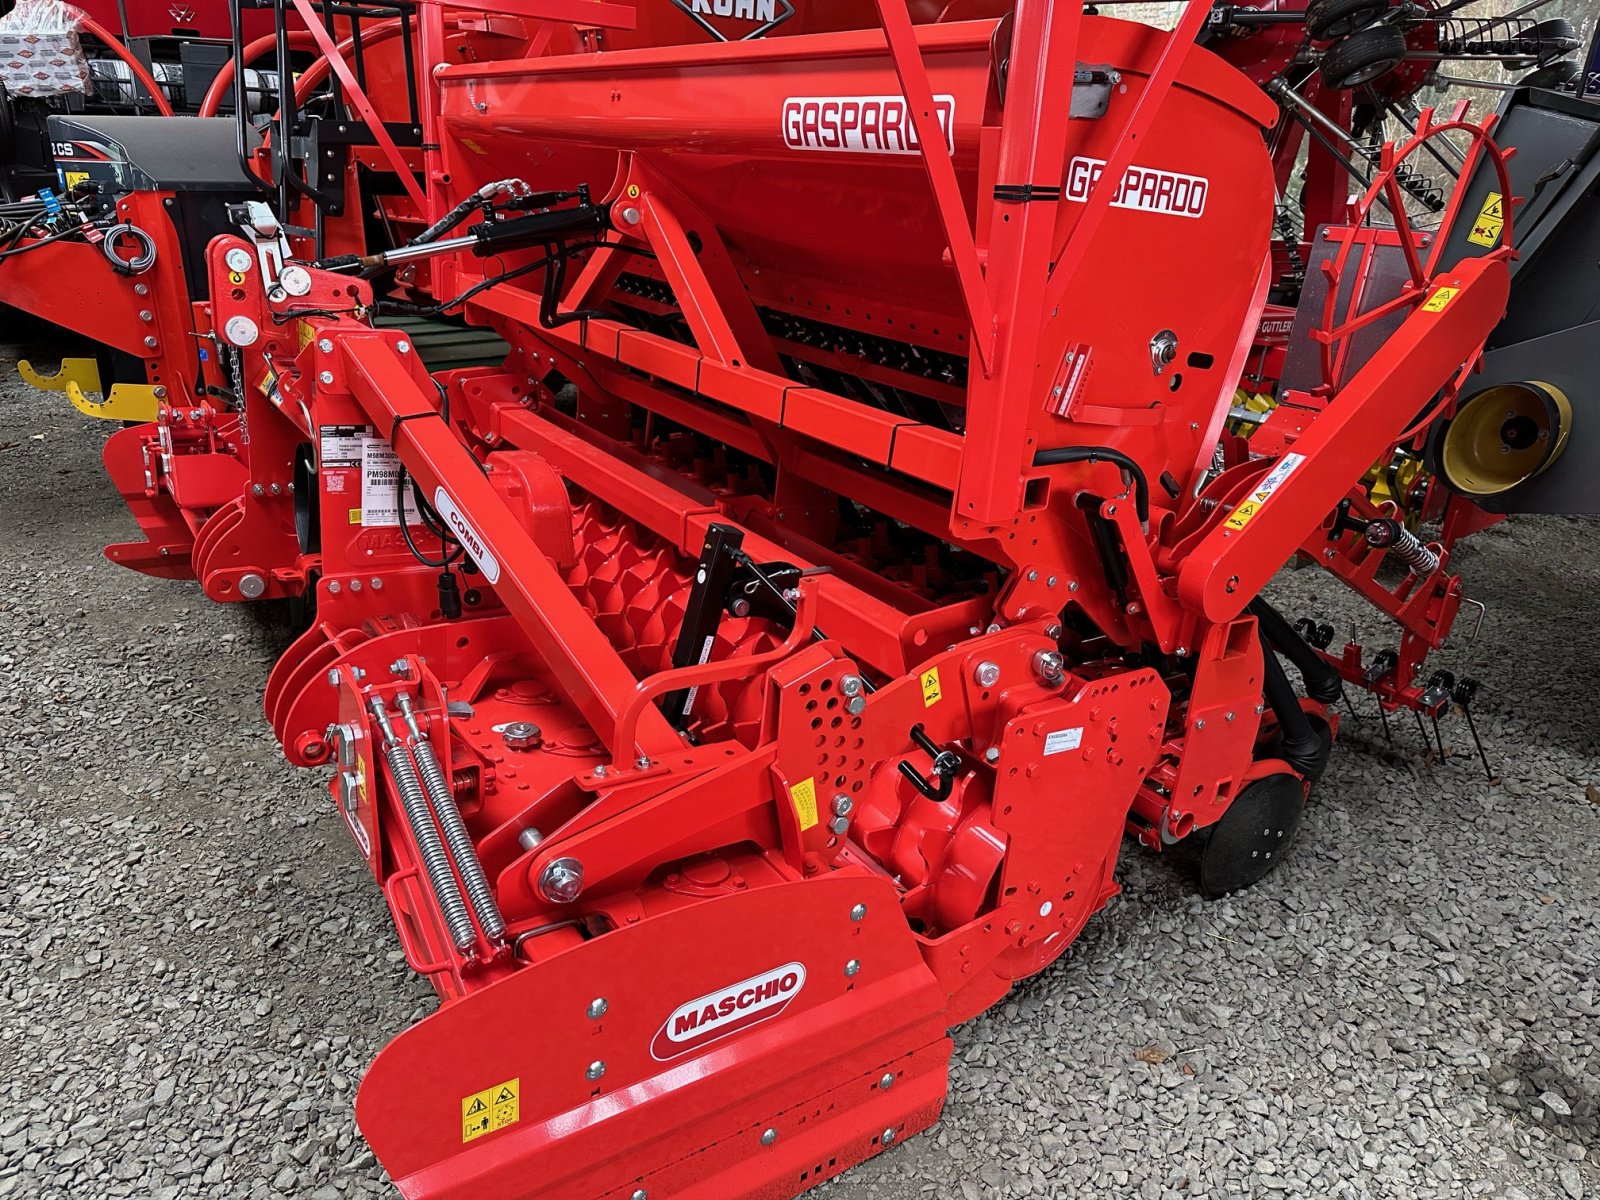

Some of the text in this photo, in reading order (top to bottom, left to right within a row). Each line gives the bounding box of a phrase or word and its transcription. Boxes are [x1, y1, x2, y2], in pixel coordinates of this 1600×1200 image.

[56, 142, 74, 156] CS
[1068, 160, 1206, 215] GAPARDO
[450, 511, 484, 561] COMBI
[674, 972, 798, 1037] MASCHIO
